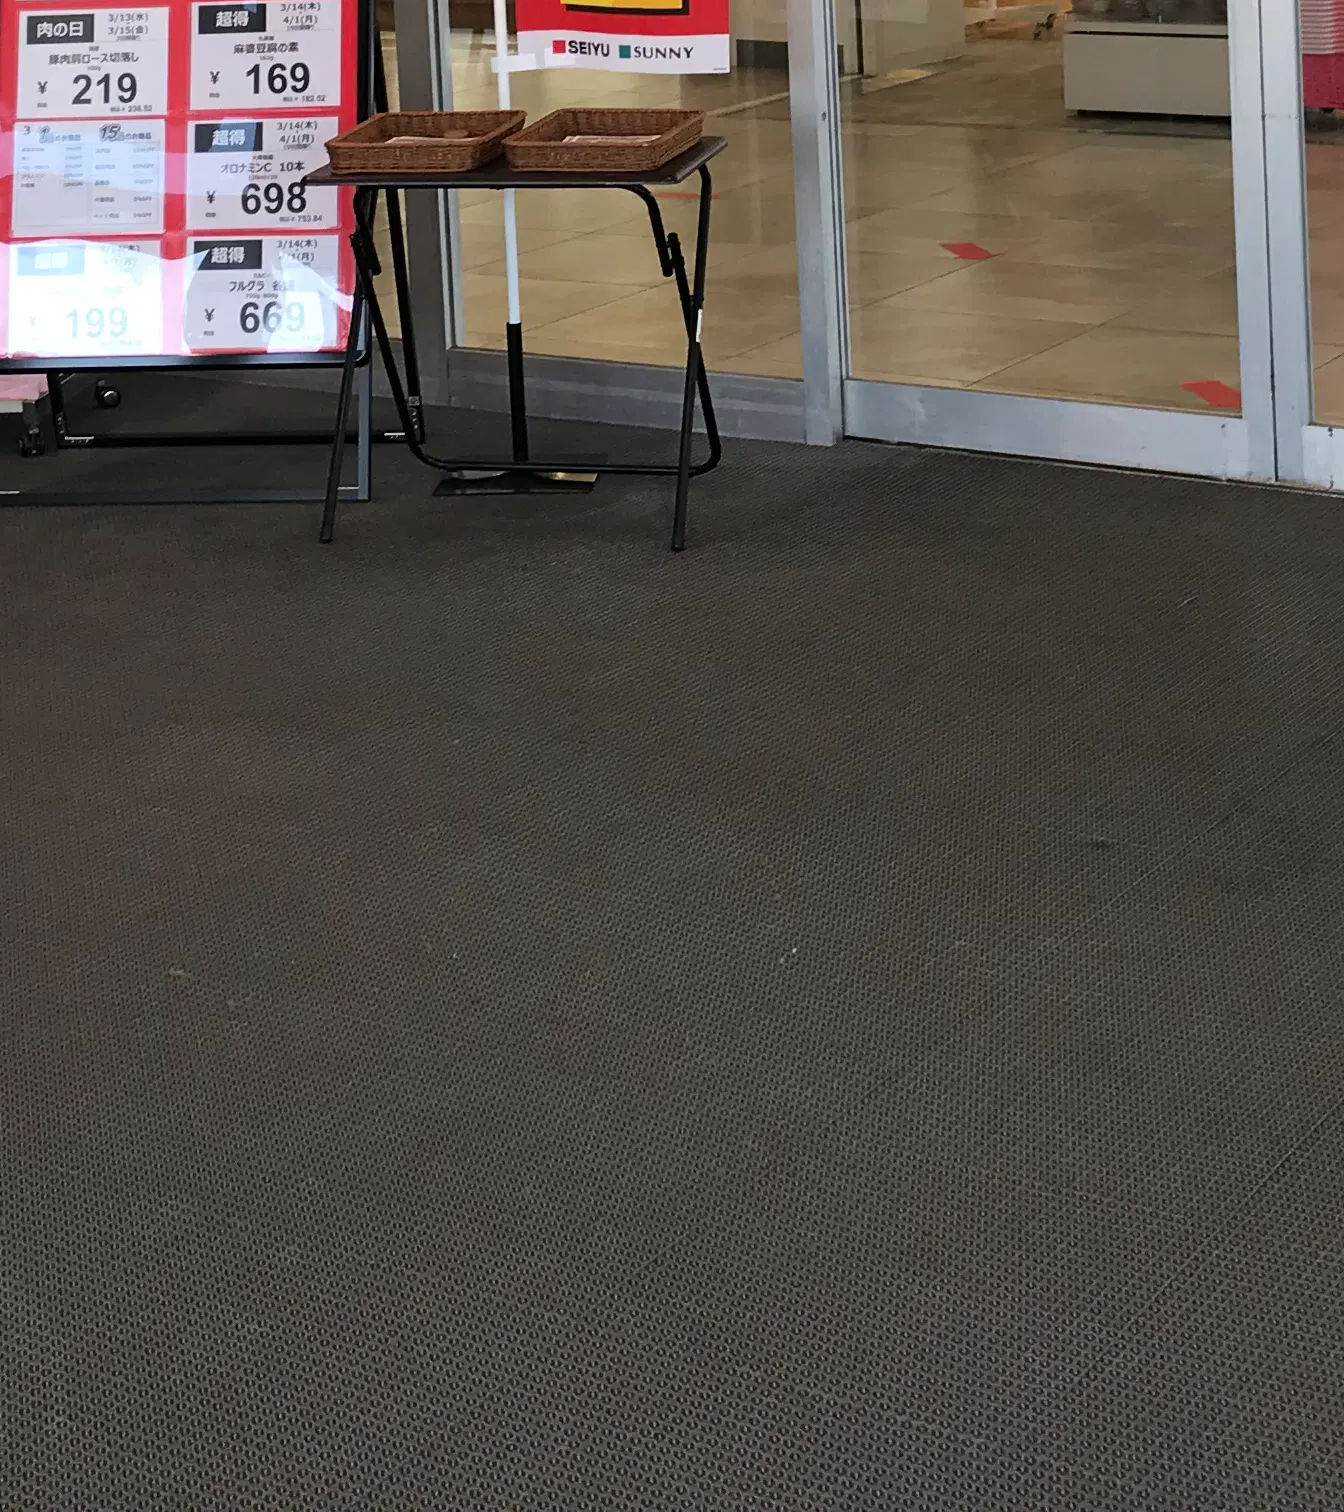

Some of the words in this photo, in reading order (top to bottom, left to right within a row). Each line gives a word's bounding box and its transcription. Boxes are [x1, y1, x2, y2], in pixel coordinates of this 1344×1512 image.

[36, 21, 84, 38] 肉の日
[108, 13, 149, 21] 3/13(水)
[216, 11, 250, 28] 超得
[280, 2, 321, 11] 3/14(木)
[283, 15, 318, 25] 4/1(月)
[108, 25, 148, 35] 3/15(金)
[233, 42, 299, 54] 麻婆豆腐の素
[568, 40, 610, 57] SEIYU
[634, 44, 694, 60] SUNNY
[37, 81, 48, 94] ¥
[72, 73, 137, 104] 219
[210, 71, 220, 85] ¥
[246, 63, 310, 94] 169
[212, 130, 246, 146] 超得
[277, 121, 318, 131] 3/14(木)
[280, 134, 315, 143] 4/1(月)
[220, 162, 272, 174] オロナミンC
[280, 161, 305, 172] 10本
[206, 191, 217, 204] ¥
[242, 183, 306, 214] 698
[211, 247, 245, 264] 超得
[276, 239, 318, 248] 3/14(木)
[229, 281, 265, 292] フルグラ
[205, 309, 215, 322] ¥
[240, 301, 305, 333] 669
